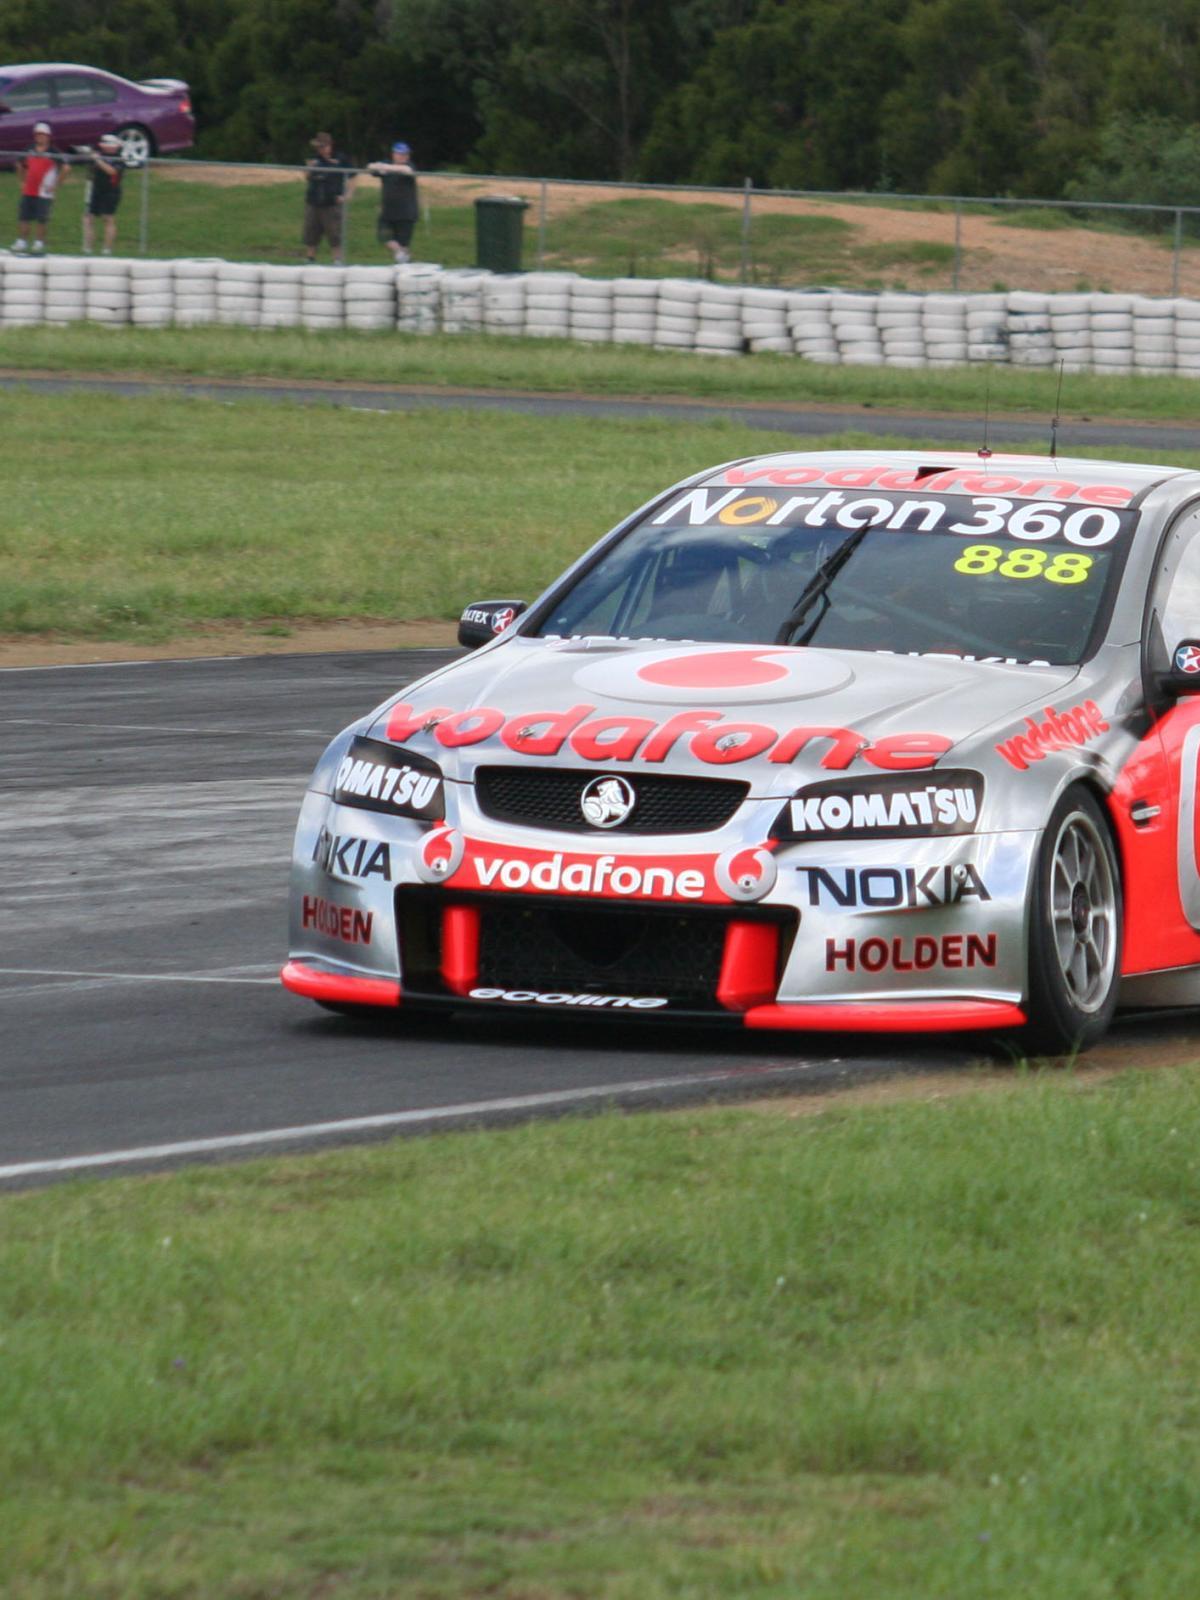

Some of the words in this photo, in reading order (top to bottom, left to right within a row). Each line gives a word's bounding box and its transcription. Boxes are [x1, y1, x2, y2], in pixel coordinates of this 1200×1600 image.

[723, 466, 1135, 505] vodafone
[653, 489, 946, 532] Norton
[949, 499, 1121, 547] 360
[953, 544, 1093, 584] 888
[385, 703, 956, 772] vodafone
[994, 699, 1111, 771] vodafone
[335, 756, 440, 809] OMATSU
[789, 786, 978, 833] KOMATSU
[473, 854, 706, 899] vodafone
[795, 863, 993, 907] NOKIA
[302, 895, 374, 945] HOLDEN
[825, 933, 998, 973] HOLDEN
